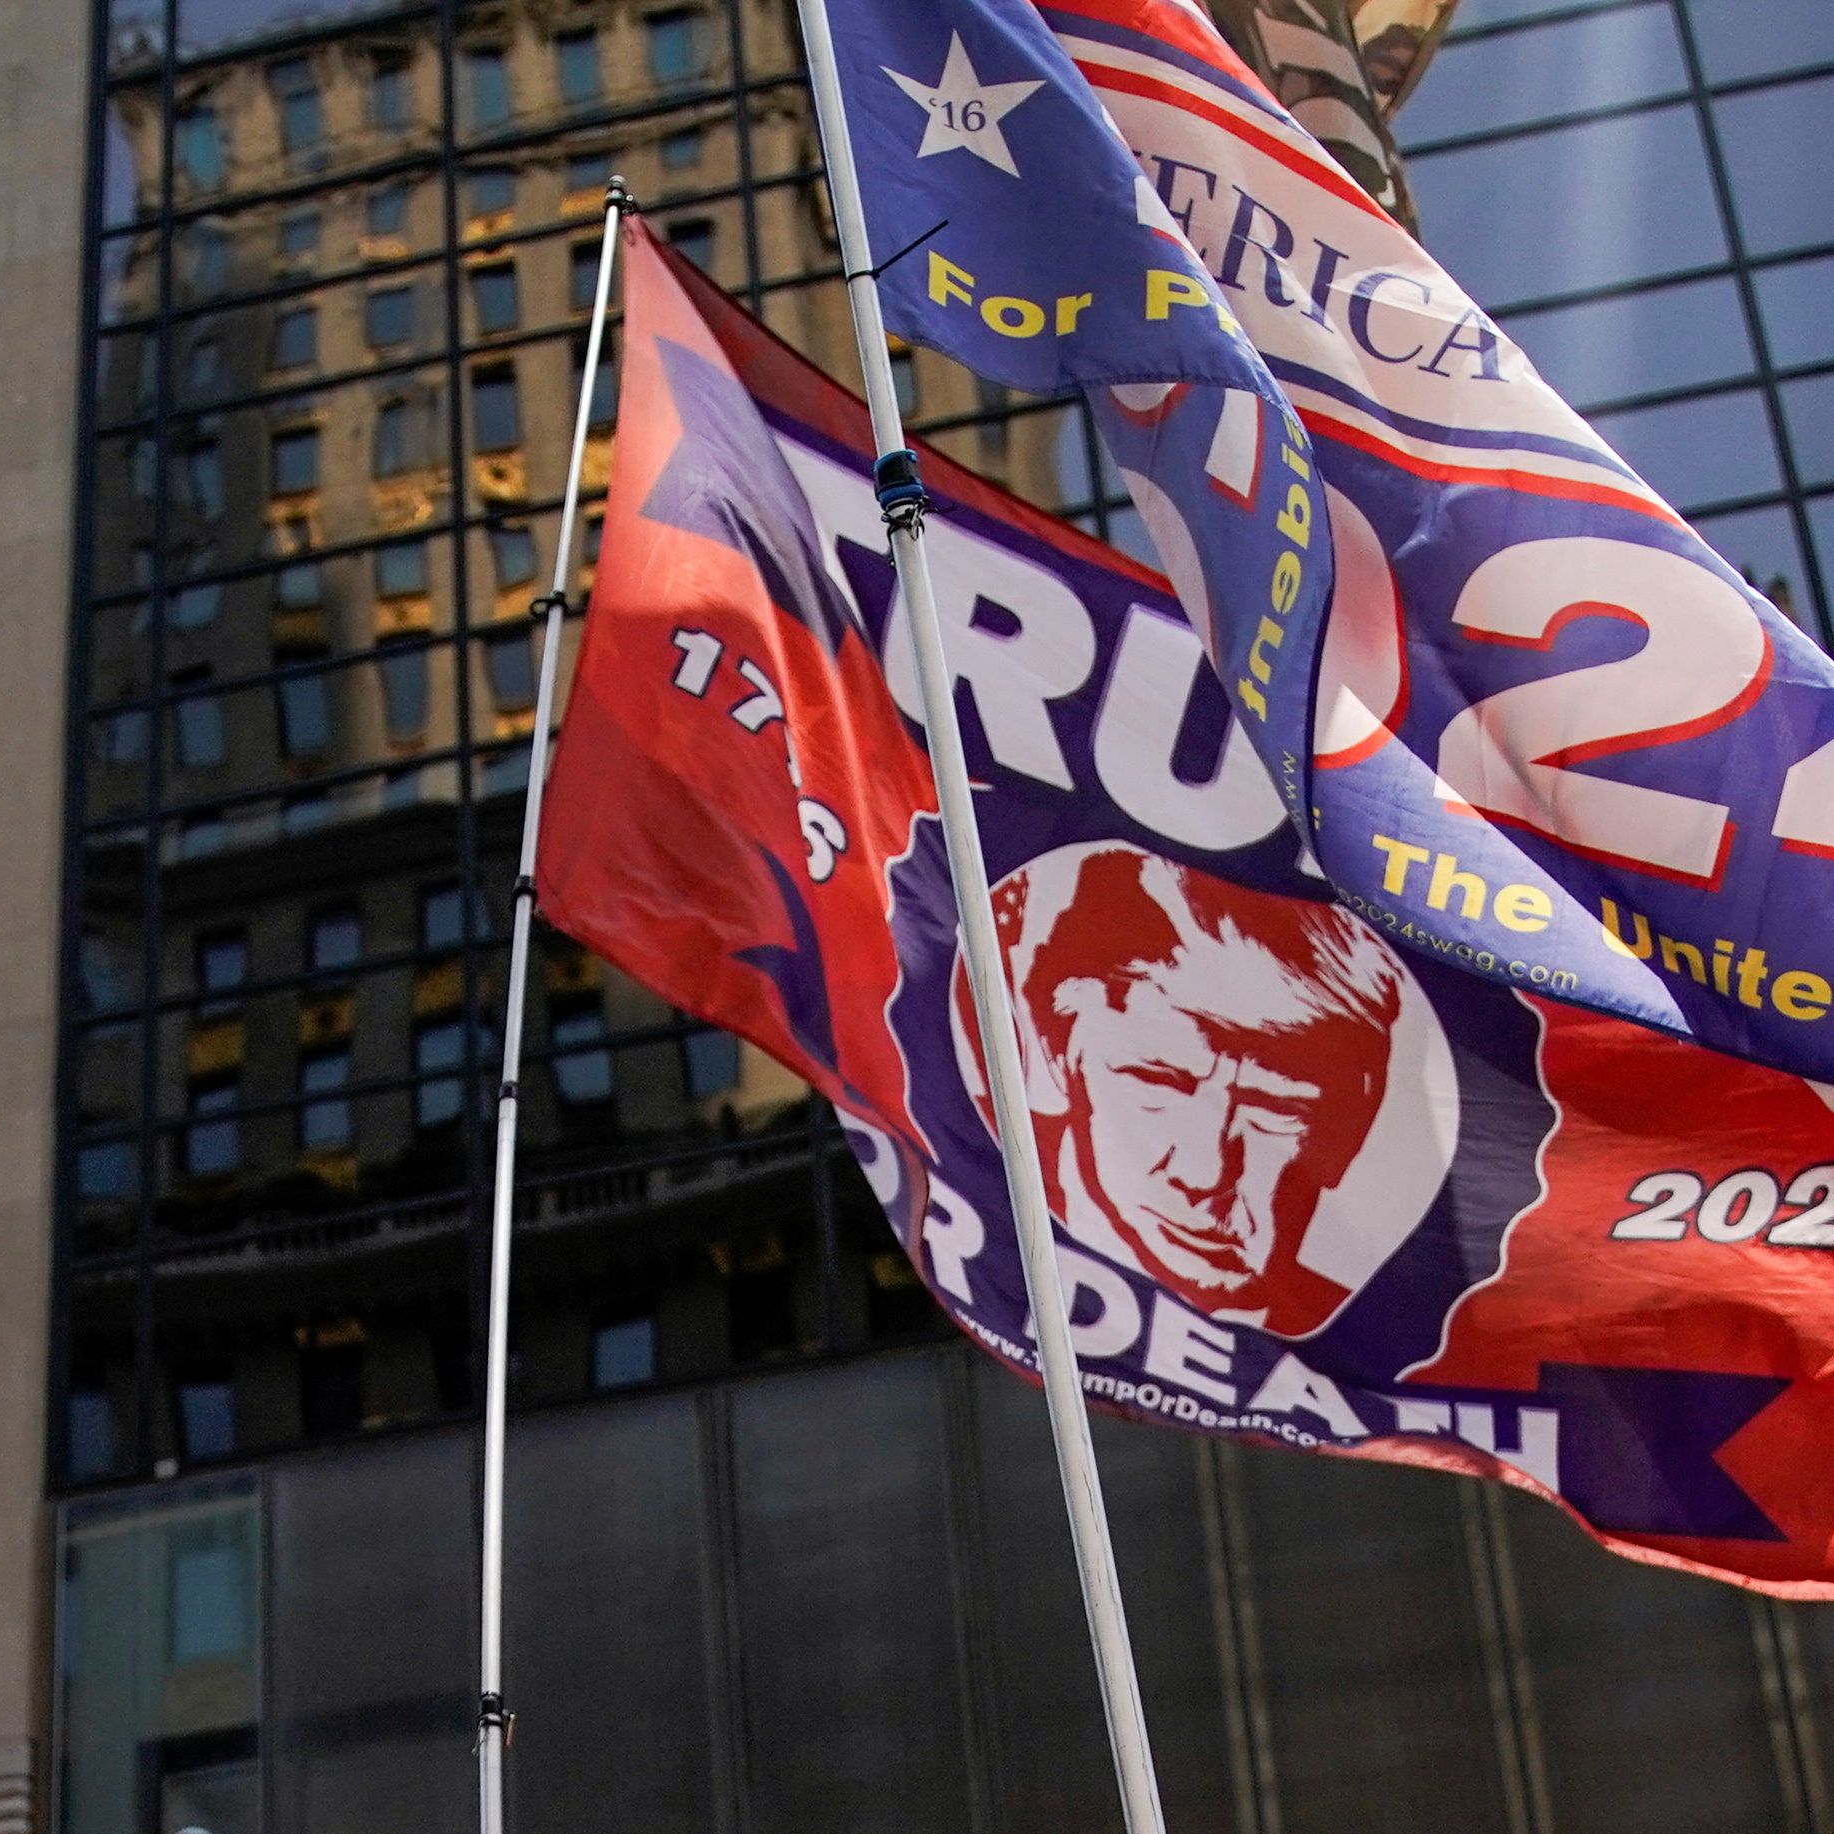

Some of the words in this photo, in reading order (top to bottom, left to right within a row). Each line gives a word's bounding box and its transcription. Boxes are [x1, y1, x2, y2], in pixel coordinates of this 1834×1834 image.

[927, 249, 1093, 338] For
[1140, 150, 1530, 383] ERICA
[1371, 833, 1554, 934] The
